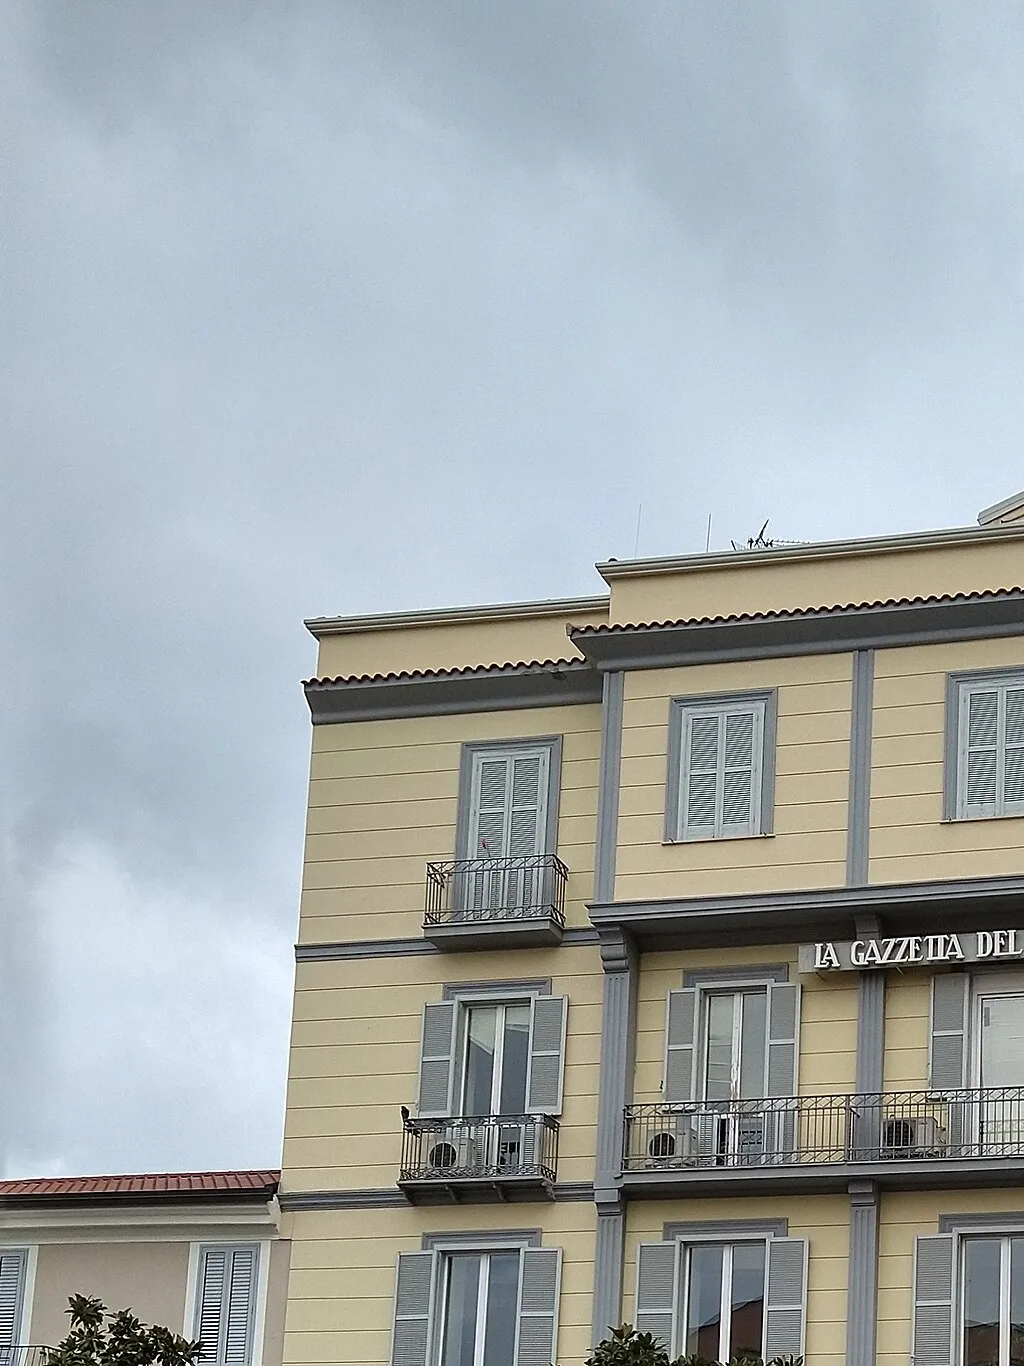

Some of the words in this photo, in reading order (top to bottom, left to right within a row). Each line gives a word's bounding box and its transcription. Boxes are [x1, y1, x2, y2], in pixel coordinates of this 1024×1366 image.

[814, 942, 841, 969] LA
[850, 934, 966, 967] GAZZETTA
[975, 930, 1024, 959] DEL
